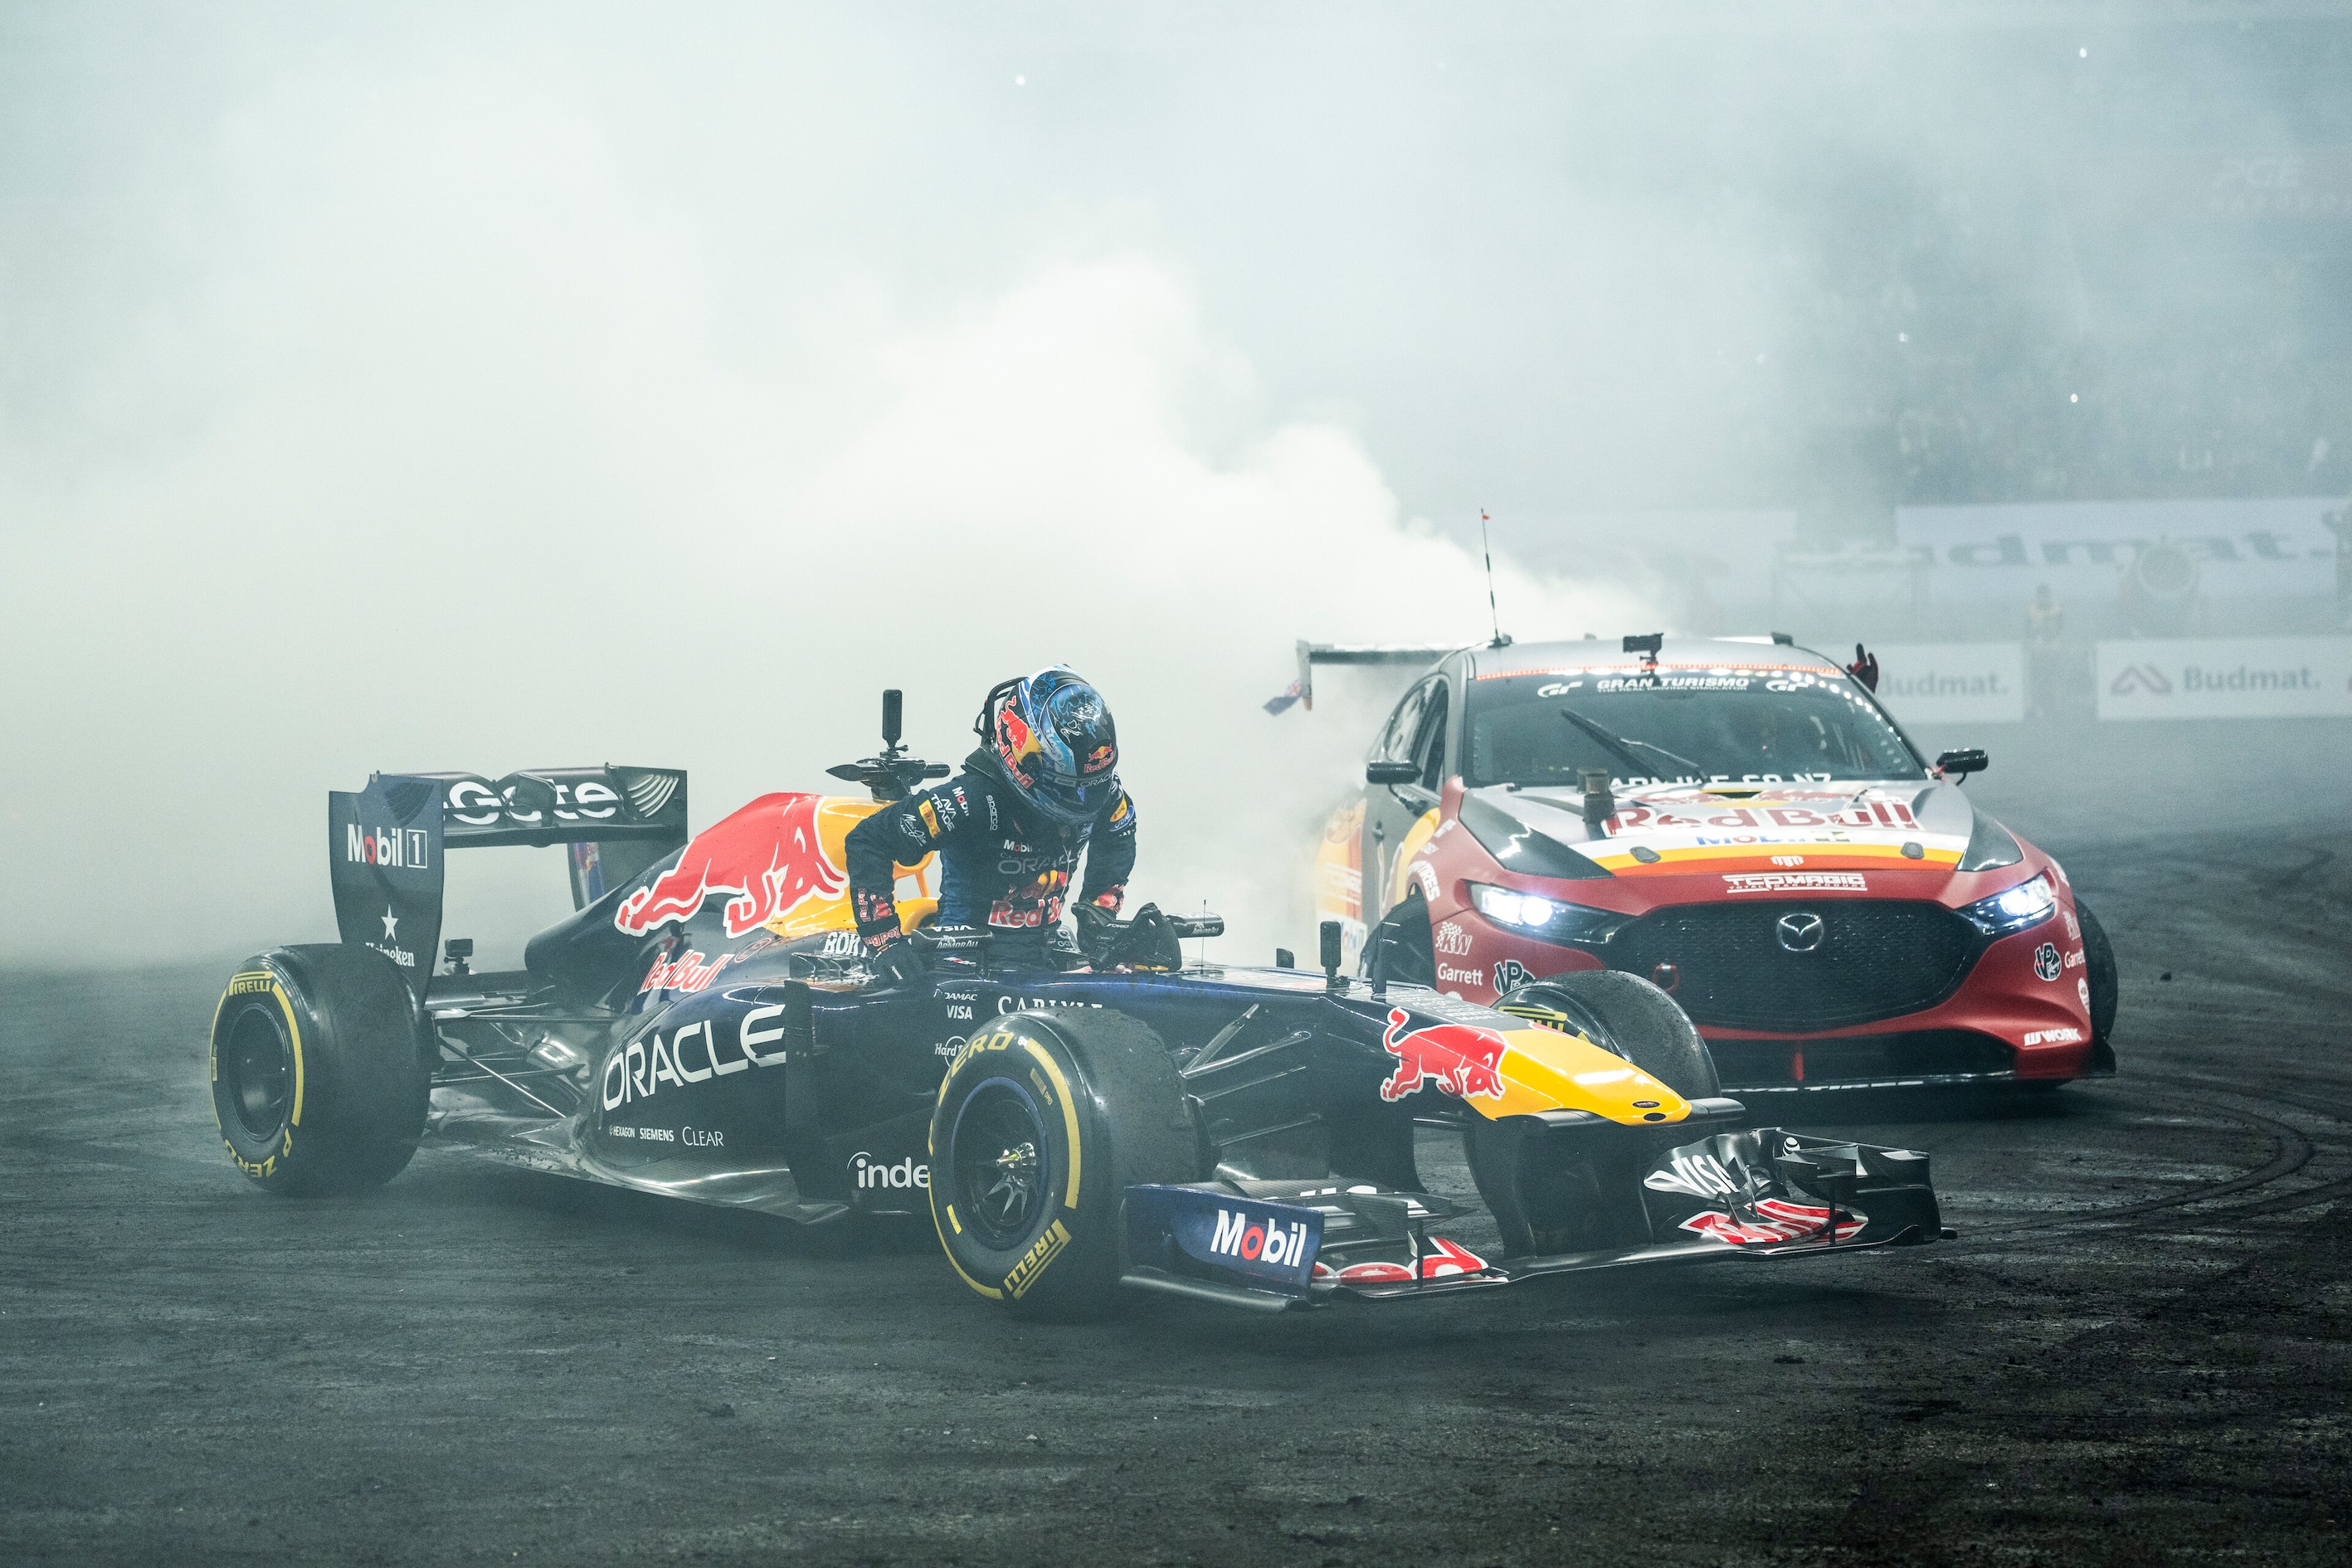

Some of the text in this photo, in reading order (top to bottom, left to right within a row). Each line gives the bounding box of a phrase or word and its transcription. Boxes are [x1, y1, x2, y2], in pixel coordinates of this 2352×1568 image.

[1596, 676, 1750, 689] GRAN TURISMO
[2184, 665, 2322, 694] Budmat.
[1005, 753, 1035, 789] Bull
[1080, 772, 1113, 787] ORACL
[1083, 762, 1103, 774] Red
[931, 794, 956, 832] TRADE
[941, 798, 957, 820] AVA
[1607, 803, 1919, 835] Red Bull
[347, 824, 402, 867] Mobil
[989, 898, 1045, 928] Red
[864, 933, 881, 947] Bul
[228, 971, 274, 996] PIRELLI
[637, 949, 735, 995] Red Bull
[1437, 962, 1484, 986] Garrett
[947, 1005, 973, 1020] VISA
[2041, 1028, 2083, 1042] WORK
[603, 1004, 786, 1112] ORACLE
[934, 1043, 957, 1056] Hard
[613, 1126, 635, 1138] HEXAGON
[640, 1127, 674, 1142] SIEMENS
[1669, 1154, 1741, 1195] VISA
[1210, 1209, 1307, 1268] Mobil
[1003, 1218, 1073, 1300] PIRELLI
